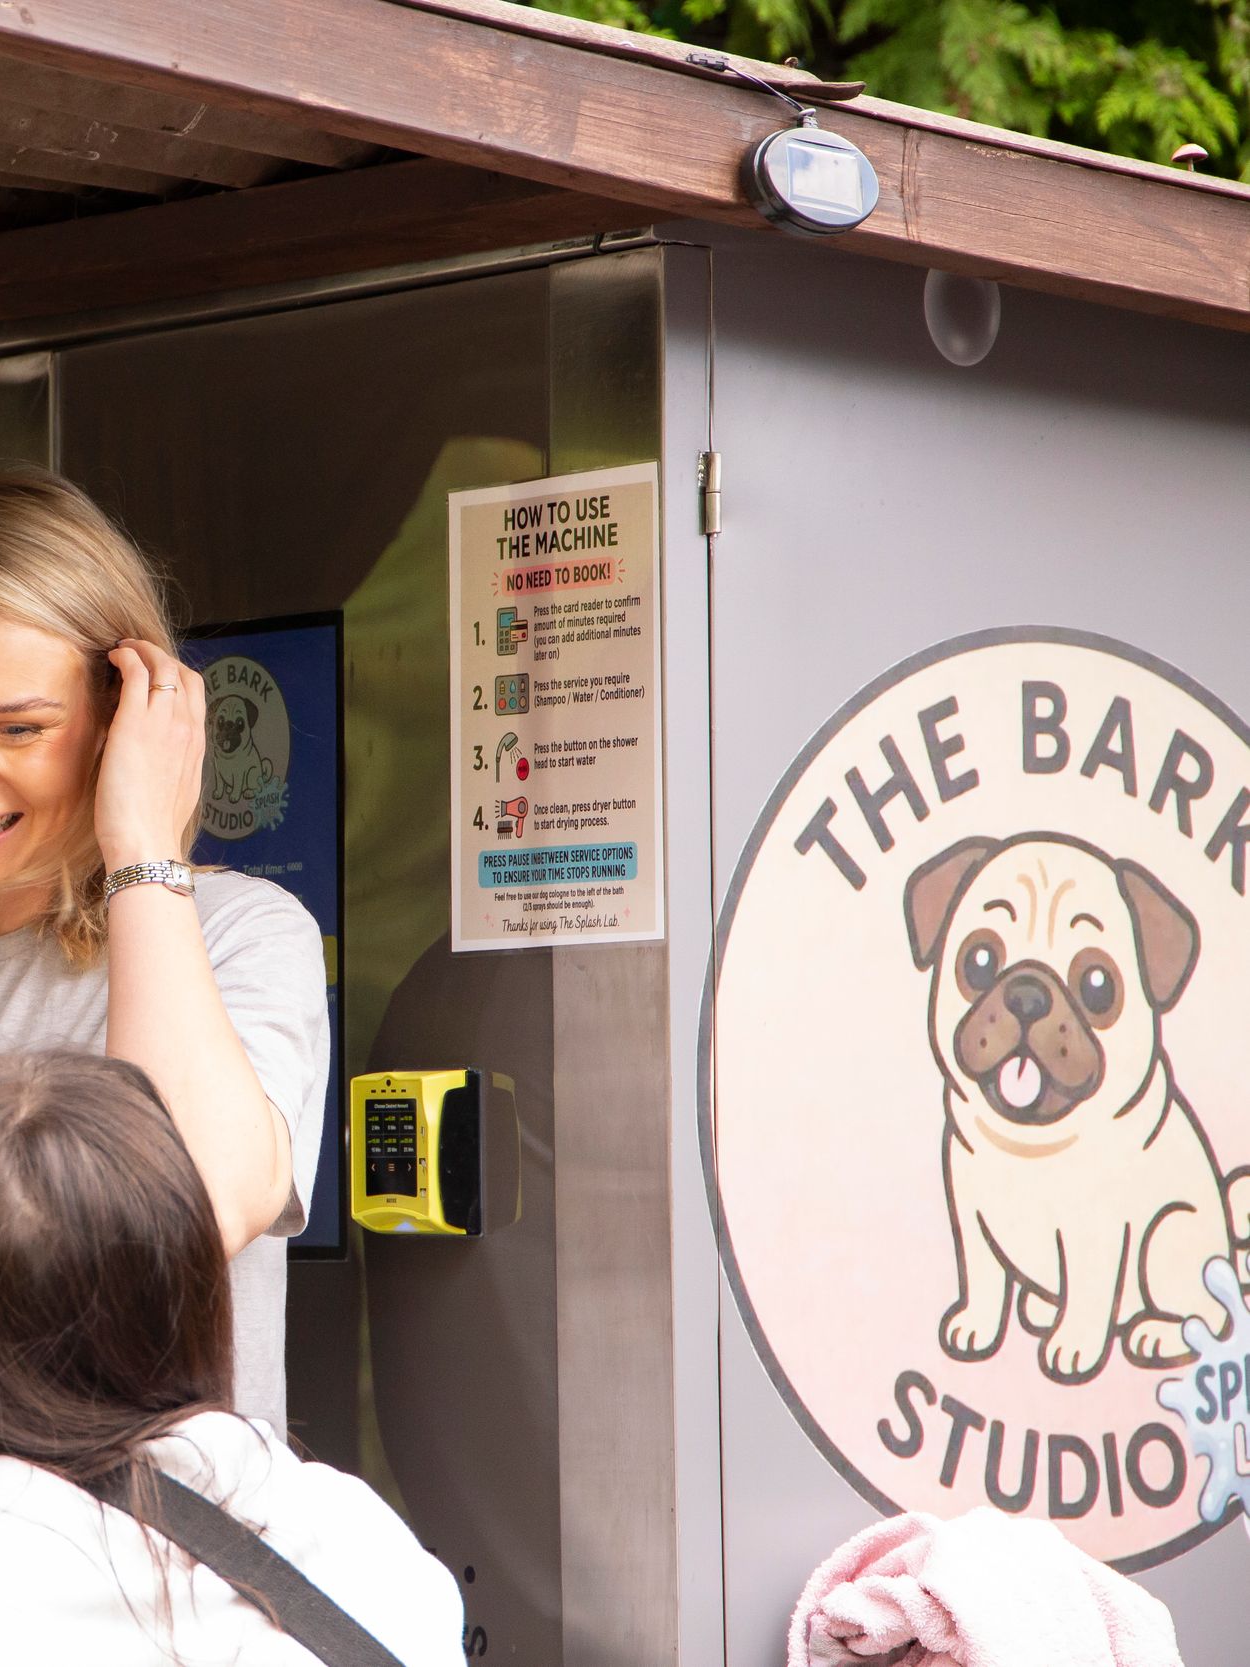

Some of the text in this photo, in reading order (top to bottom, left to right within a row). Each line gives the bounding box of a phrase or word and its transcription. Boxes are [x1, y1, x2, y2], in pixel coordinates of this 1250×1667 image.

[504, 496, 610, 531] HOW TO USE
[497, 523, 618, 560] THE MACHINE
[507, 563, 610, 591] NO NEED TO BOOK!
[534, 595, 640, 617] Press the card reader to confirm
[534, 612, 625, 631] amount of minutes required
[474, 621, 485, 646] 1.
[534, 626, 641, 648] (you can add additional minutes
[534, 648, 559, 661] later on)
[227, 664, 274, 703] BARK
[534, 673, 630, 692] Press the service you require
[473, 685, 487, 710] 2.
[534, 692, 566, 707] (Shampoo
[572, 688, 593, 703] Water
[600, 685, 644, 701] Conditioner)
[534, 736, 638, 754] Press the button on the shower
[473, 746, 488, 770] 3.
[534, 757, 548, 769] head
[549, 759, 557, 768] to
[558, 756, 575, 767] start
[577, 754, 596, 765] water
[793, 679, 1250, 898] THE BARK
[202, 802, 254, 830] STUDIO
[473, 806, 489, 830] 4.
[534, 799, 636, 815] Once clean, press dryer button
[534, 816, 609, 831] to start drying process.
[484, 846, 633, 868] PRESS PAUSE INBETWEEN SERVICE OPTIONS
[243, 864, 263, 876] Total
[265, 864, 285, 875] time:
[492, 864, 625, 884] TO ENSURE YOUR TIME STOPS RUNNING
[494, 893, 505, 901] Feel
[506, 892, 516, 900] free
[517, 892, 523, 900] to
[540, 891, 548, 900] dog
[549, 889, 569, 900] cologne
[570, 889, 576, 897] to
[577, 888, 586, 897] the
[586, 888, 595, 896] left
[596, 887, 602, 896] of
[603, 887, 611, 895] the
[613, 886, 624, 894] bath
[547, 901, 563, 910] should
[503, 914, 619, 936] Thanks for using The Splash Lab.
[877, 1368, 1188, 1522] STUDIO
